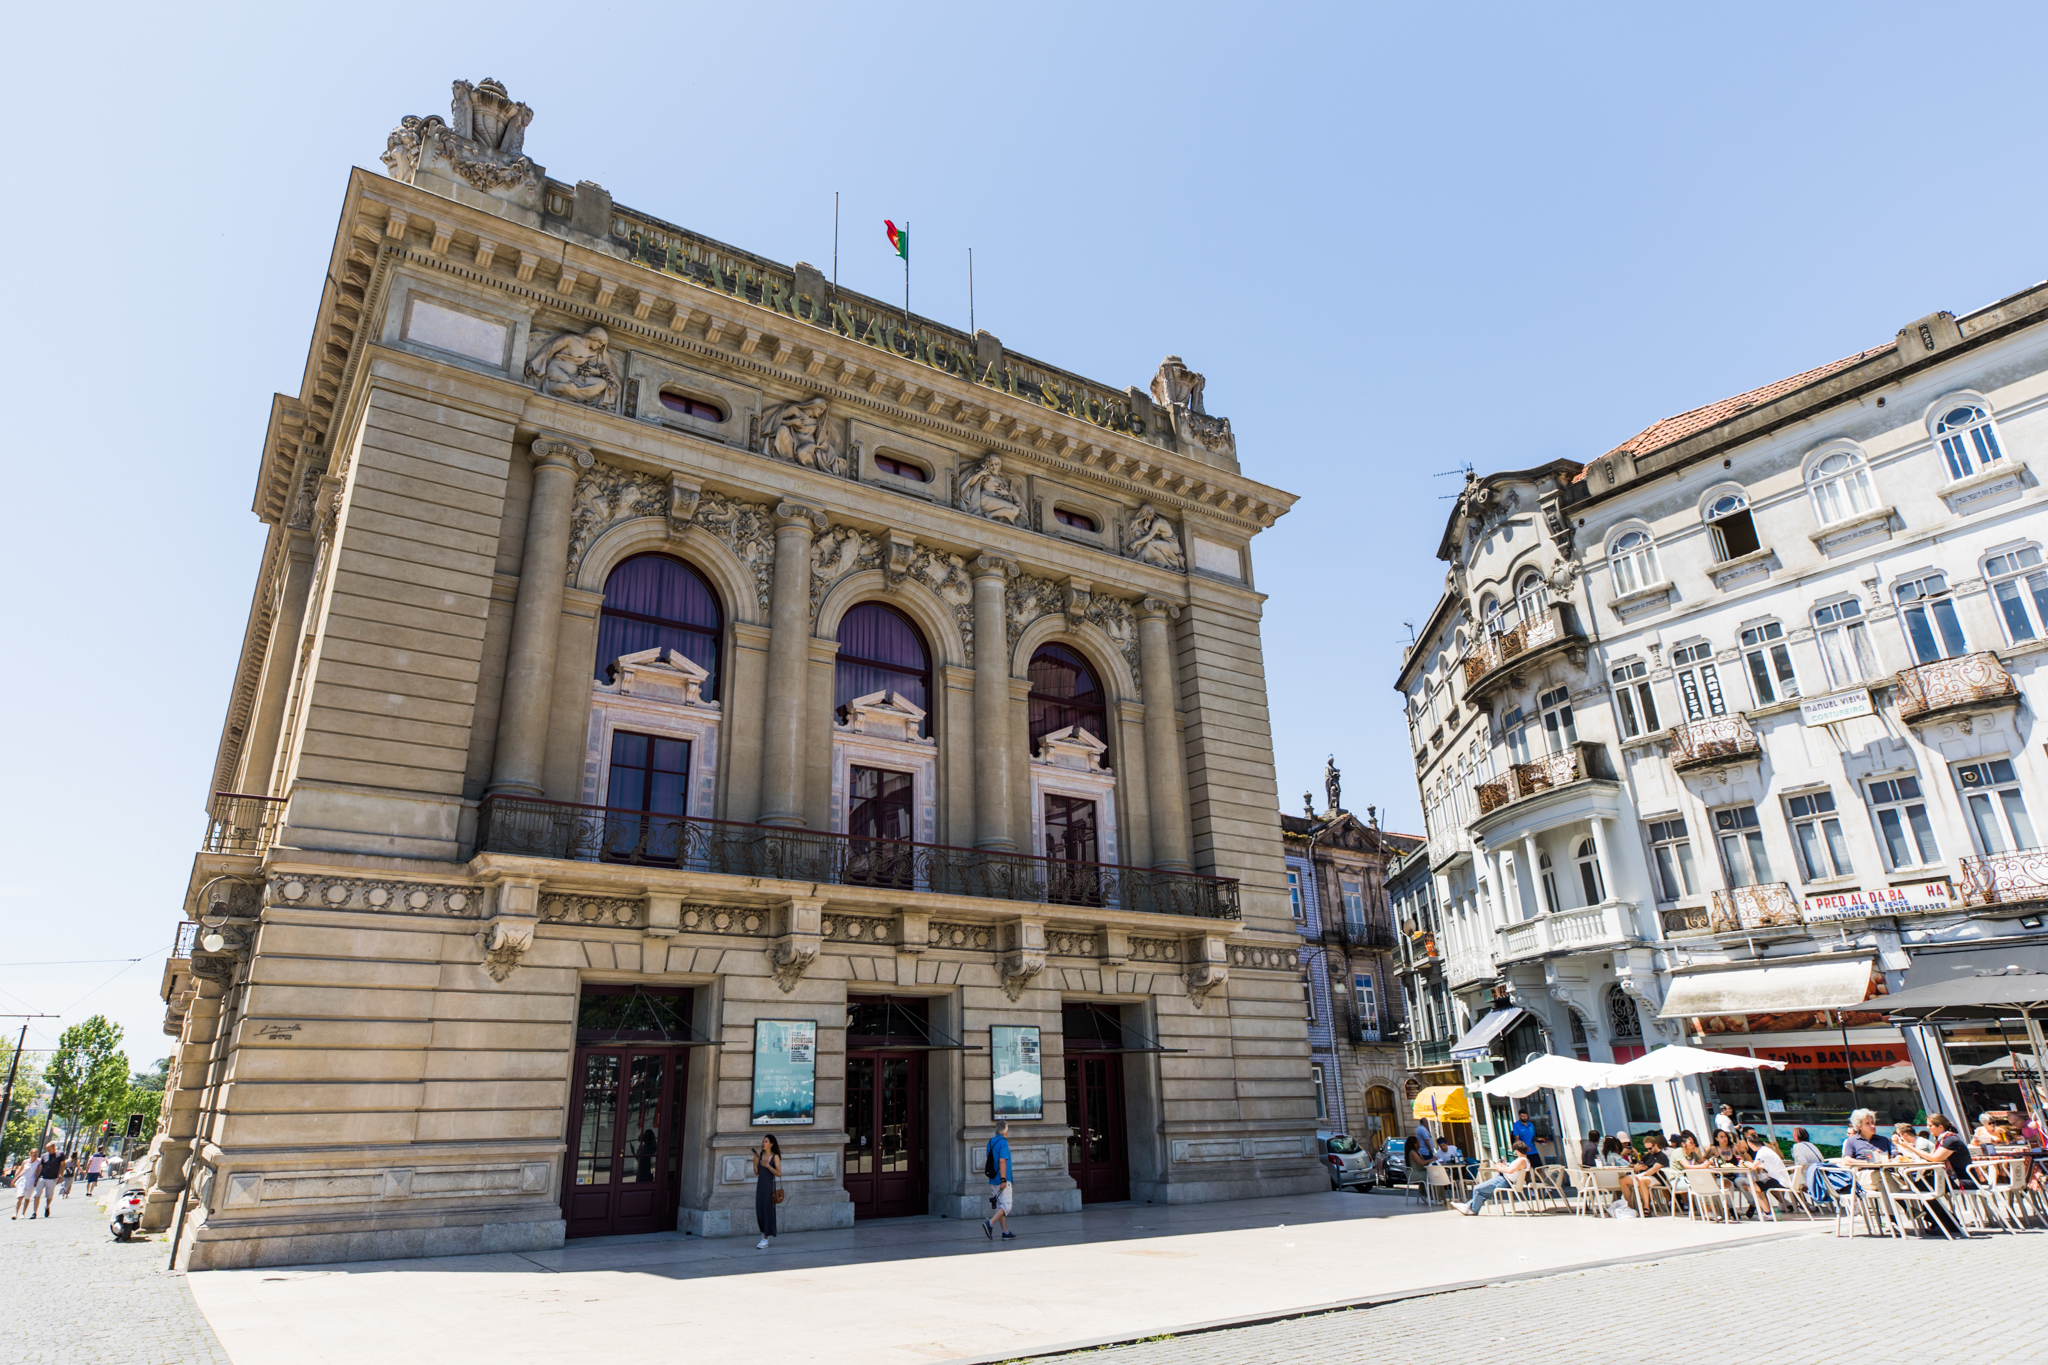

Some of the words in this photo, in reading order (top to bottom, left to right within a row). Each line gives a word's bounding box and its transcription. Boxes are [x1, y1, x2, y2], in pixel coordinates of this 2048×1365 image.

[628, 228, 821, 325] TEATRO
[828, 302, 1031, 401] NACIONAL
[539, 413, 598, 435] BONDADE
[1682, 673, 1703, 720] CALISTA
[1704, 667, 1724, 714] SANTOS
[1804, 700, 1838, 713] MANUEL
[1840, 694, 1867, 705] VIEIRA
[1812, 705, 1865, 721] COSTUREIRO
[1804, 900, 1811, 911] A
[1838, 904, 1870, 913] COMPRA
[1883, 899, 1909, 908] VENDE
[1884, 902, 1946, 915] PROPRIEDADES
[1768, 1052, 1812, 1064] Talho
[1816, 1050, 1897, 1063] BATALHA
